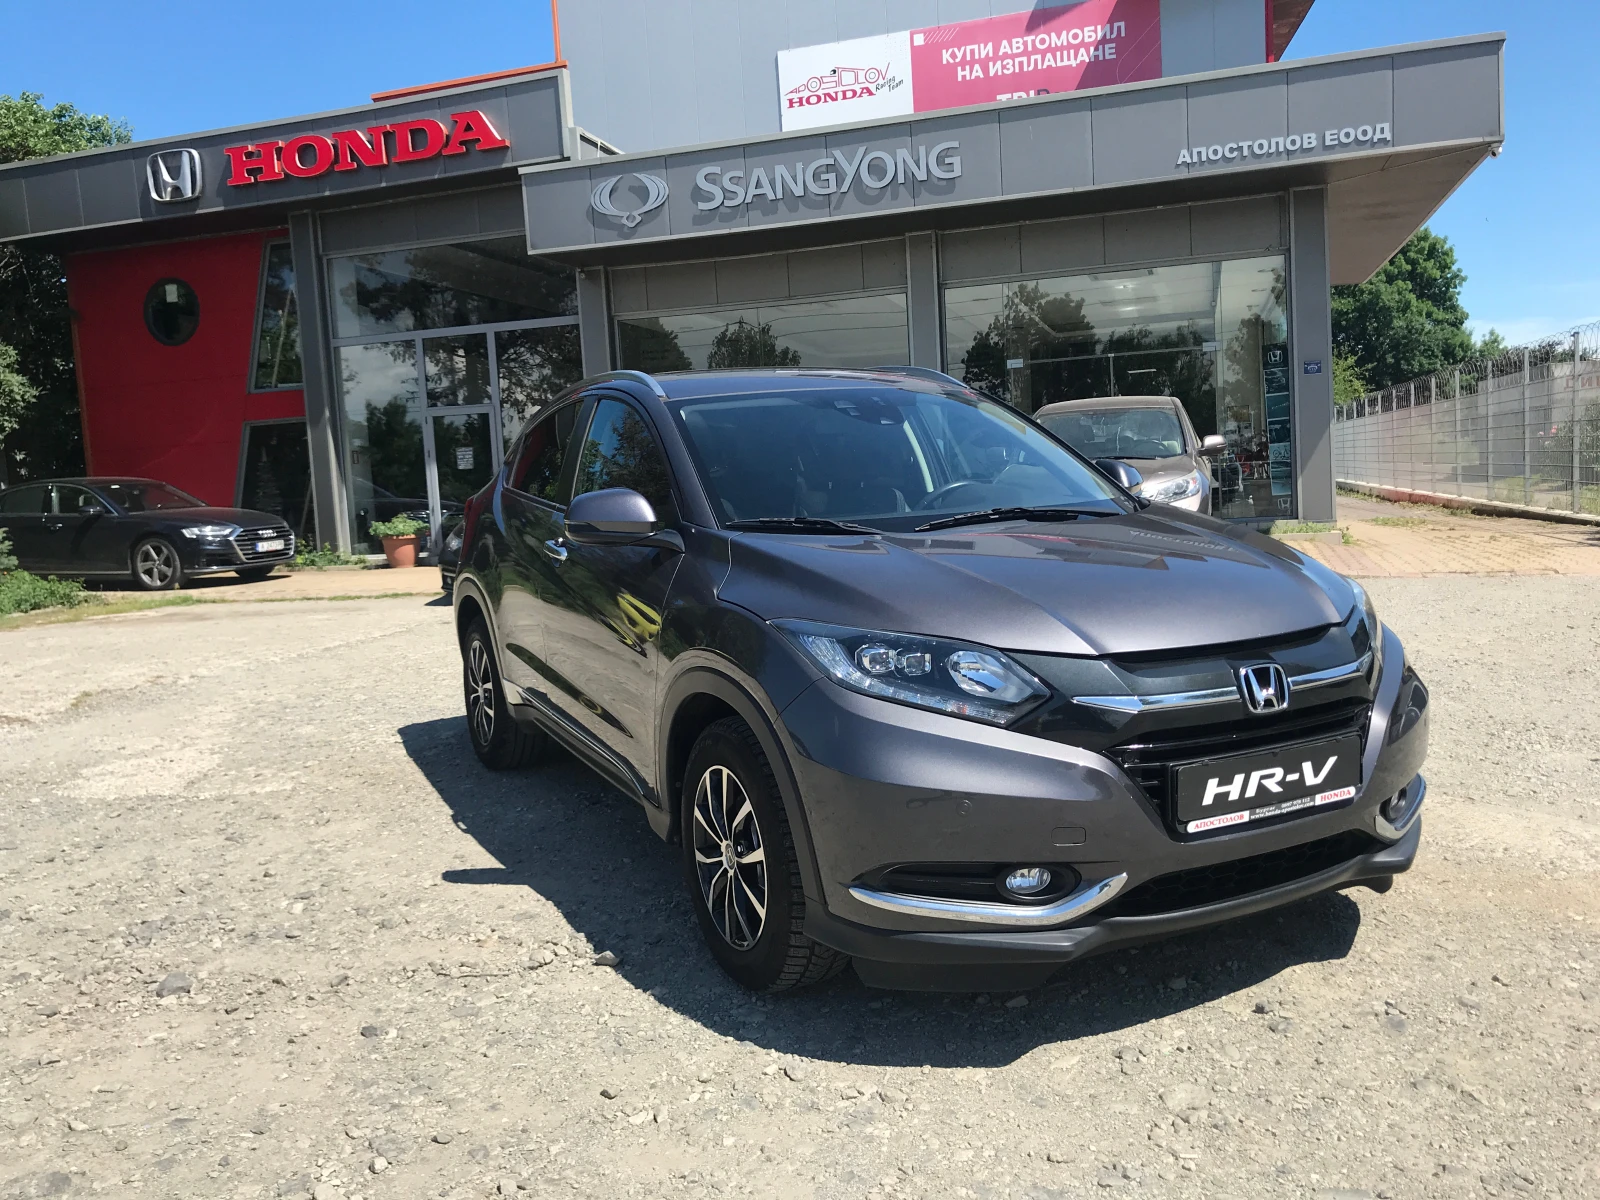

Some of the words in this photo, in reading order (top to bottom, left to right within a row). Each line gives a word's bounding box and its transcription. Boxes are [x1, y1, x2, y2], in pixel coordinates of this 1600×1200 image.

[942, 41, 993, 64] КУПИ
[999, 21, 1126, 56] АВТОМОБИЛ
[957, 64, 984, 82] НА
[989, 43, 1117, 77] ИЗПЛАЩАНЕ
[787, 86, 876, 109] HONDA
[875, 76, 896, 92] Racing
[887, 79, 904, 92] Team
[224, 110, 510, 186] HONDA
[1176, 132, 1317, 165] АПОСТОЛОВ
[1324, 122, 1392, 146] ЕООД
[696, 141, 962, 210] SSANGYONG
[1201, 755, 1338, 806] HR-V
[1319, 788, 1352, 802] HONDA
[1194, 813, 1245, 830] АПОСТОЛОВ
